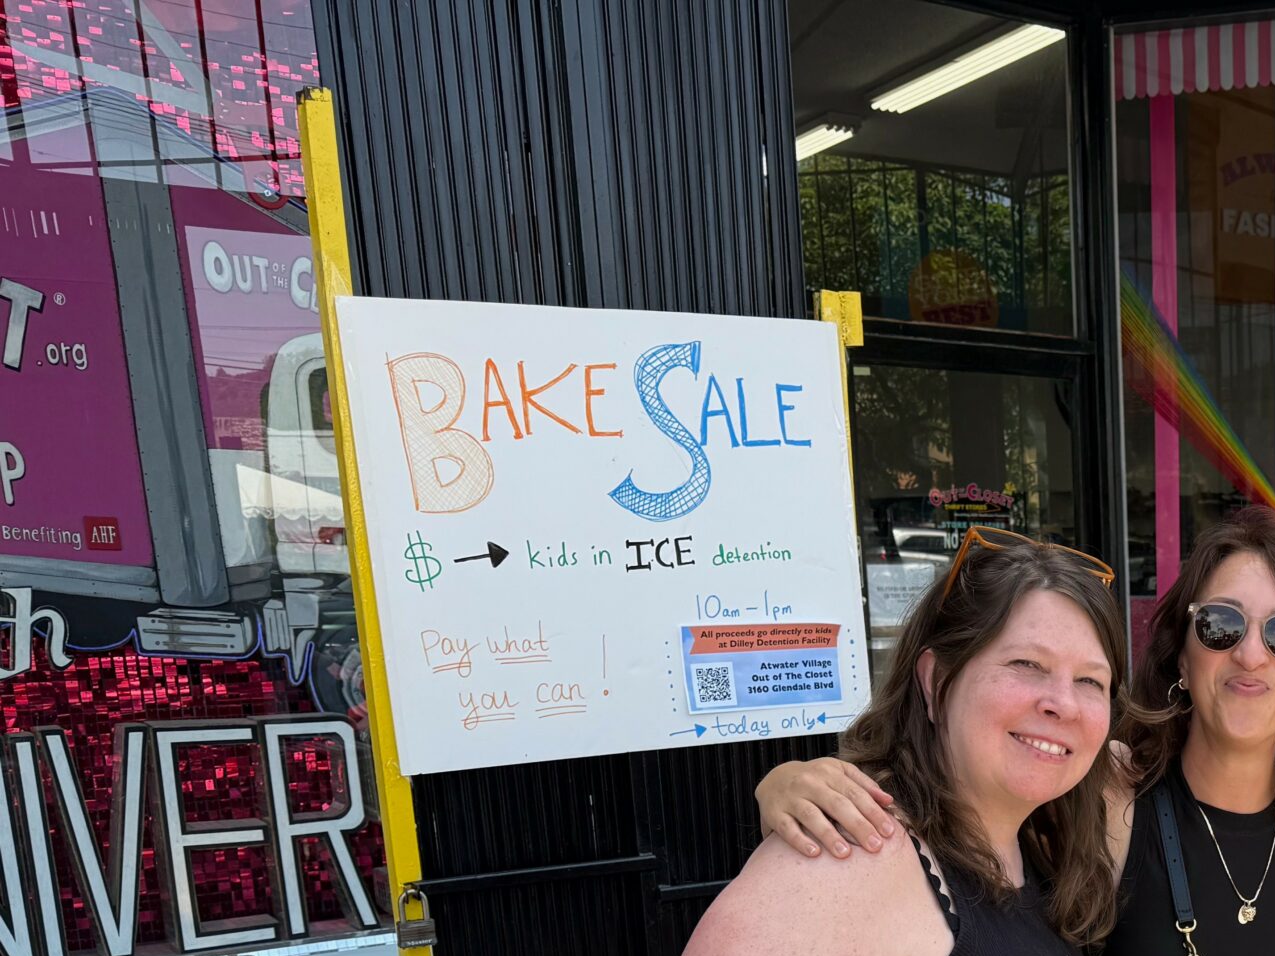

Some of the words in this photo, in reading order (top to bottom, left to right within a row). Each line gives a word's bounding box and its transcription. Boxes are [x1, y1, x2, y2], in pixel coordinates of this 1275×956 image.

[202, 240, 269, 294] OUT
[272, 262, 286, 273] OF
[272, 275, 288, 289] THE
[37, 342, 87, 370] .org
[385, 352, 625, 514] BAKE
[607, 340, 812, 523] SALE
[2, 525, 81, 551] Benefiting
[91, 525, 116, 544] AHF
[526, 539, 578, 569] kids
[591, 545, 612, 566] in
[625, 535, 696, 573] ICE
[712, 541, 792, 567] detention
[700, 630, 713, 639] All
[715, 628, 755, 640] proceeds
[757, 629, 768, 638] go
[770, 627, 802, 637] directly
[815, 626, 832, 635] kids
[718, 641, 728, 649] at
[730, 639, 754, 649] Dilley
[756, 638, 800, 647] Detention
[802, 636, 832, 646] Facility
[421, 629, 480, 678] Pay
[487, 620, 551, 655] what
[751, 673, 770, 682] Out
[772, 672, 783, 681] of
[785, 672, 802, 680] The
[804, 670, 833, 679] Closet
[760, 660, 799, 670] Atwater
[801, 659, 832, 668] Village
[747, 685, 770, 695] 3160
[772, 683, 812, 693] Glendale
[814, 681, 834, 691] Blvd
[459, 690, 520, 731] you
[536, 682, 586, 704] can
[711, 715, 772, 737] today
[781, 709, 816, 730] only
